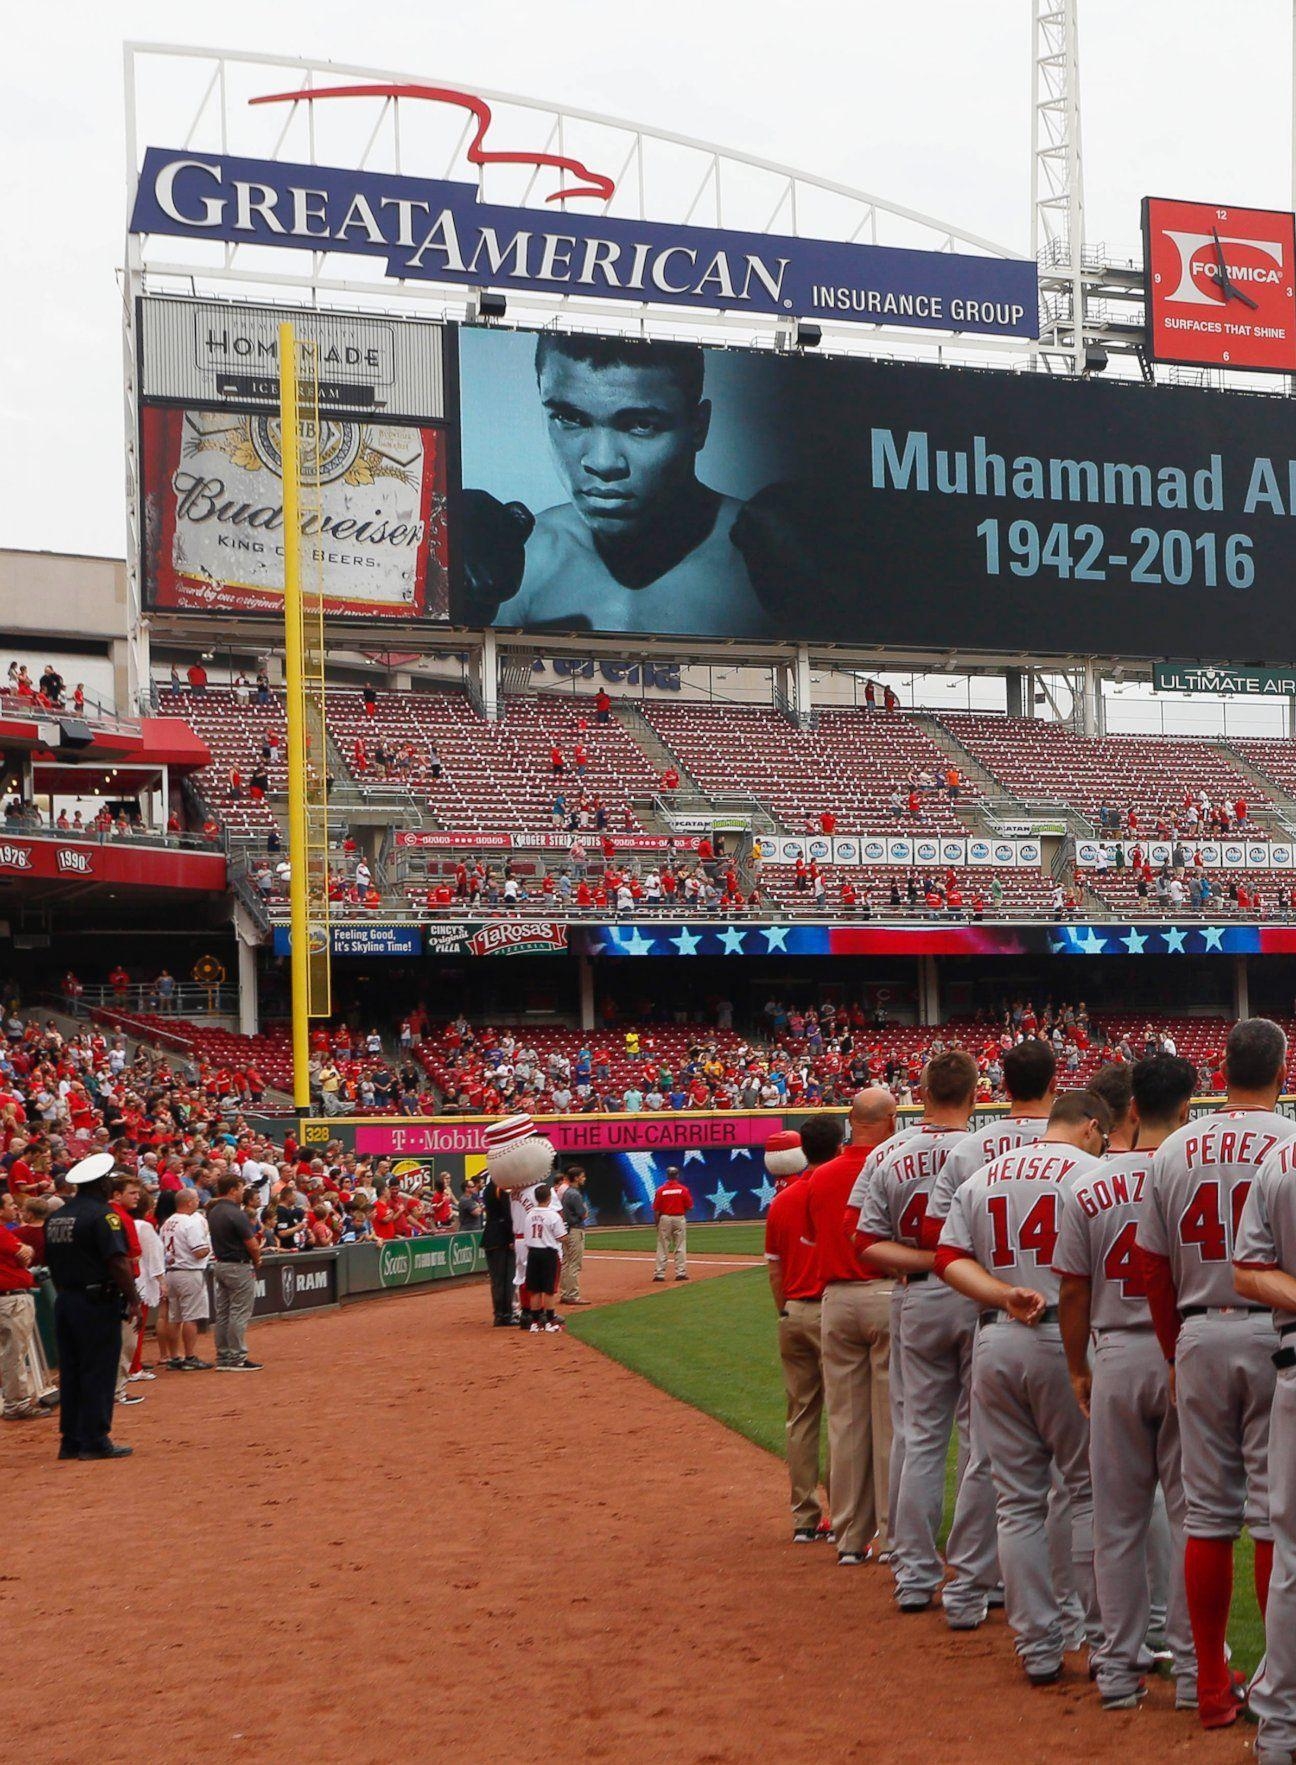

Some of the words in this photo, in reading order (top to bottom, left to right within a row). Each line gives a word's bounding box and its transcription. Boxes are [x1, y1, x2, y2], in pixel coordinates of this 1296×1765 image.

[1216, 210, 1228, 220] 12
[1154, 273, 1161, 283] 9
[1192, 261, 1280, 284] FORMICA
[1286, 287, 1293, 297] 3
[812, 285, 943, 319] INSURANCE
[950, 299, 1025, 325] GROUP
[1164, 317, 1222, 333] SURFACES
[1223, 323, 1251, 336] THAT
[1253, 326, 1286, 339] SHINE
[205, 329, 380, 367] HOMMADE
[1223, 351, 1230, 361] 6
[251, 382, 280, 395] ICE
[871, 427, 1225, 512] Muhammad
[218, 534, 264, 553] KING
[976, 518, 1256, 589] 1942-2016
[1160, 674, 1260, 693] ULTIMATE
[1263, 679, 1296, 694] AIR
[60, 850, 87, 871] 1990
[334, 928, 368, 942] Feeling
[369, 928, 397, 942] Good,
[428, 932, 469, 947] Original
[334, 940, 349, 952] It's
[351, 940, 386, 954] Skyline
[387, 940, 412, 952] Time!
[435, 943, 461, 953] PIZZA
[306, 1126, 330, 1143] 328
[559, 1126, 601, 1146] THE
[607, 1123, 737, 1144] UN-CARRIER
[1185, 1122, 1280, 1172] PÉREZ
[987, 1155, 1077, 1187] HEISEY
[987, 1192, 1060, 1270] 14
[383, 1251, 409, 1276] Scotts
[296, 1271, 328, 1292] RAM
